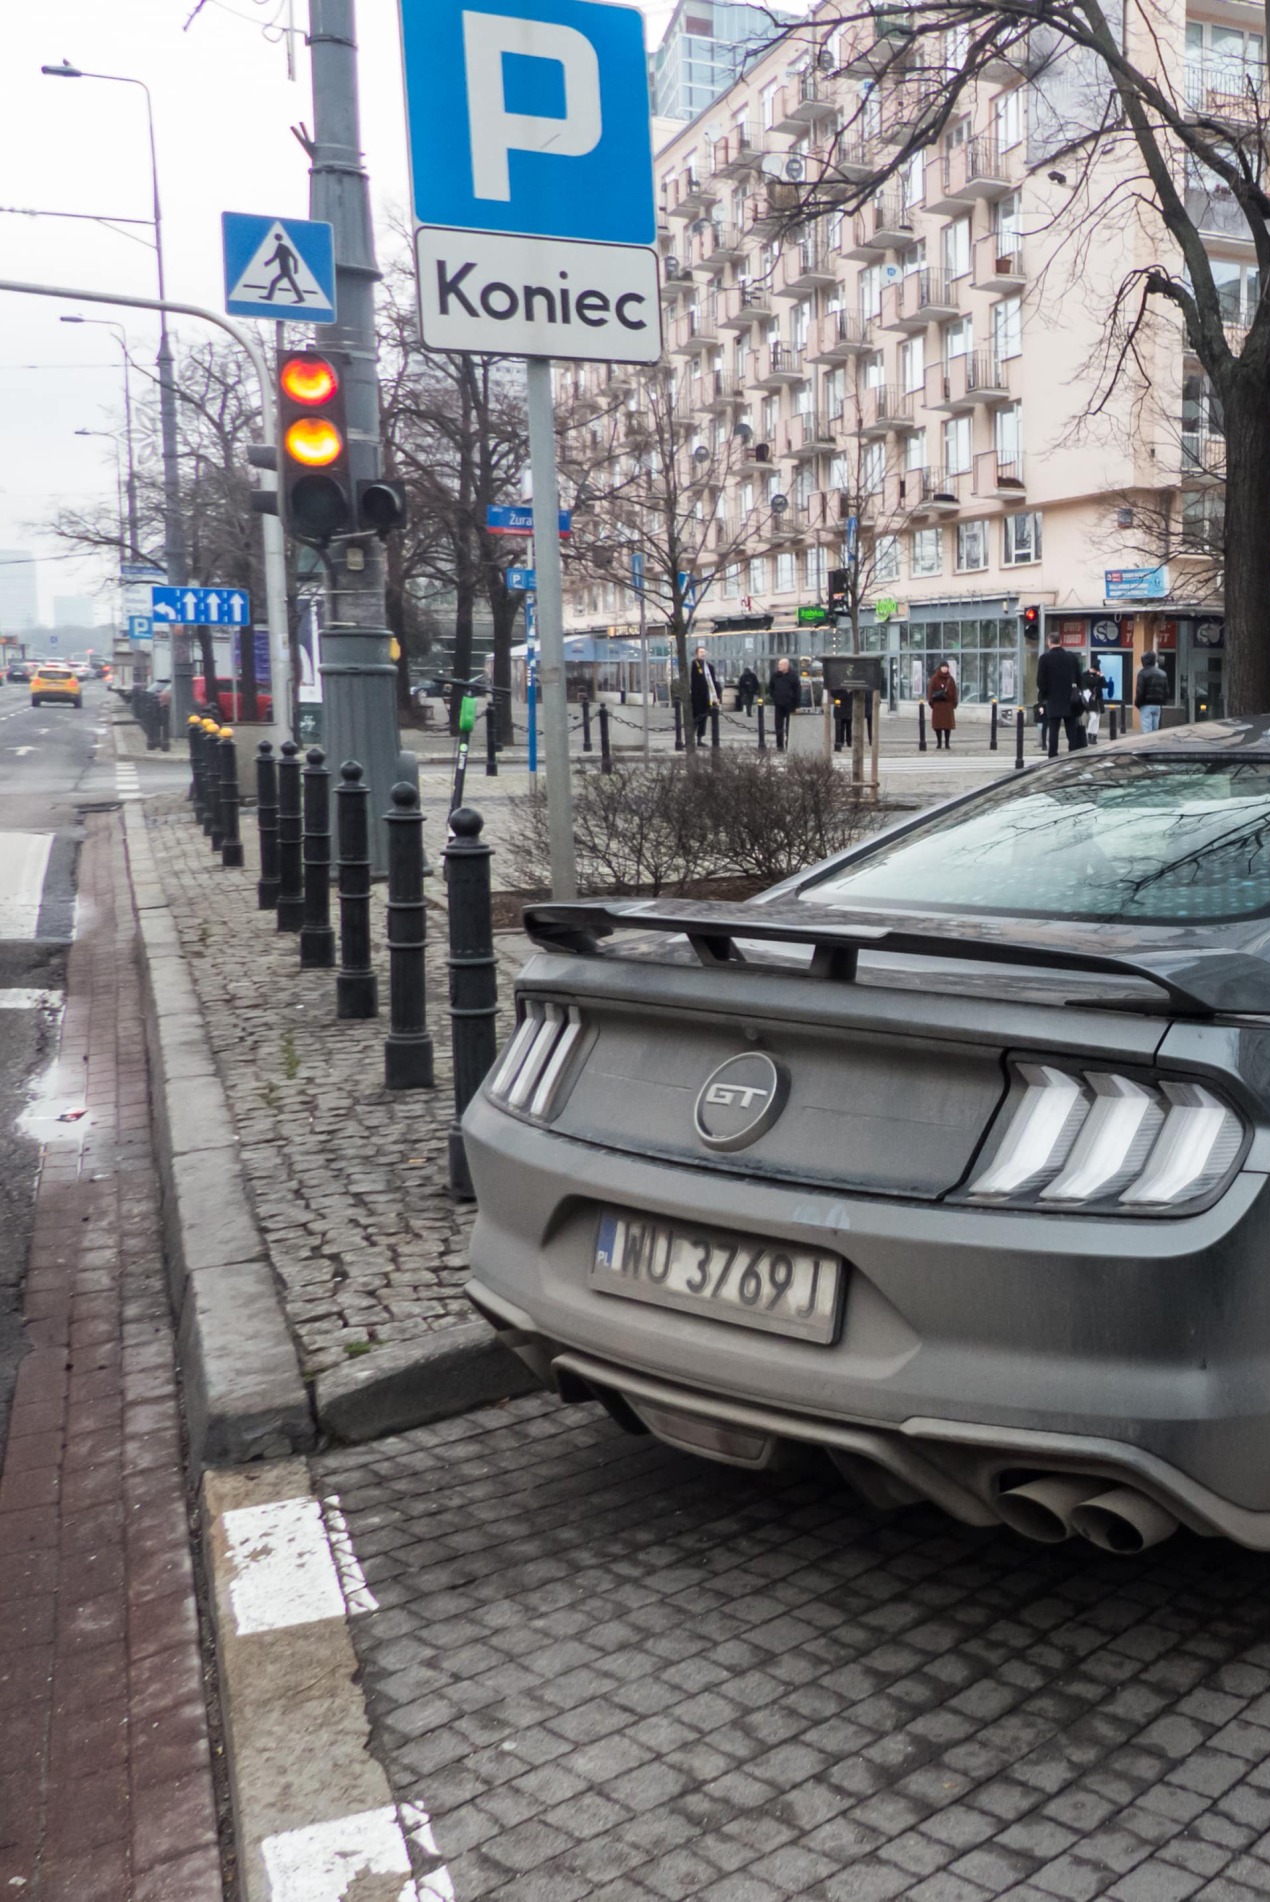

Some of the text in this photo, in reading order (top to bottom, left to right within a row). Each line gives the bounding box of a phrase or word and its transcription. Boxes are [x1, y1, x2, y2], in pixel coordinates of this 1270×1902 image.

[462, 10, 602, 202] P
[436, 259, 648, 331] Koniec
[509, 511, 533, 526] Żura
[705, 1082, 769, 1110] GT
[597, 1250, 610, 1267] PL
[622, 1220, 820, 1319] WU 3769J
